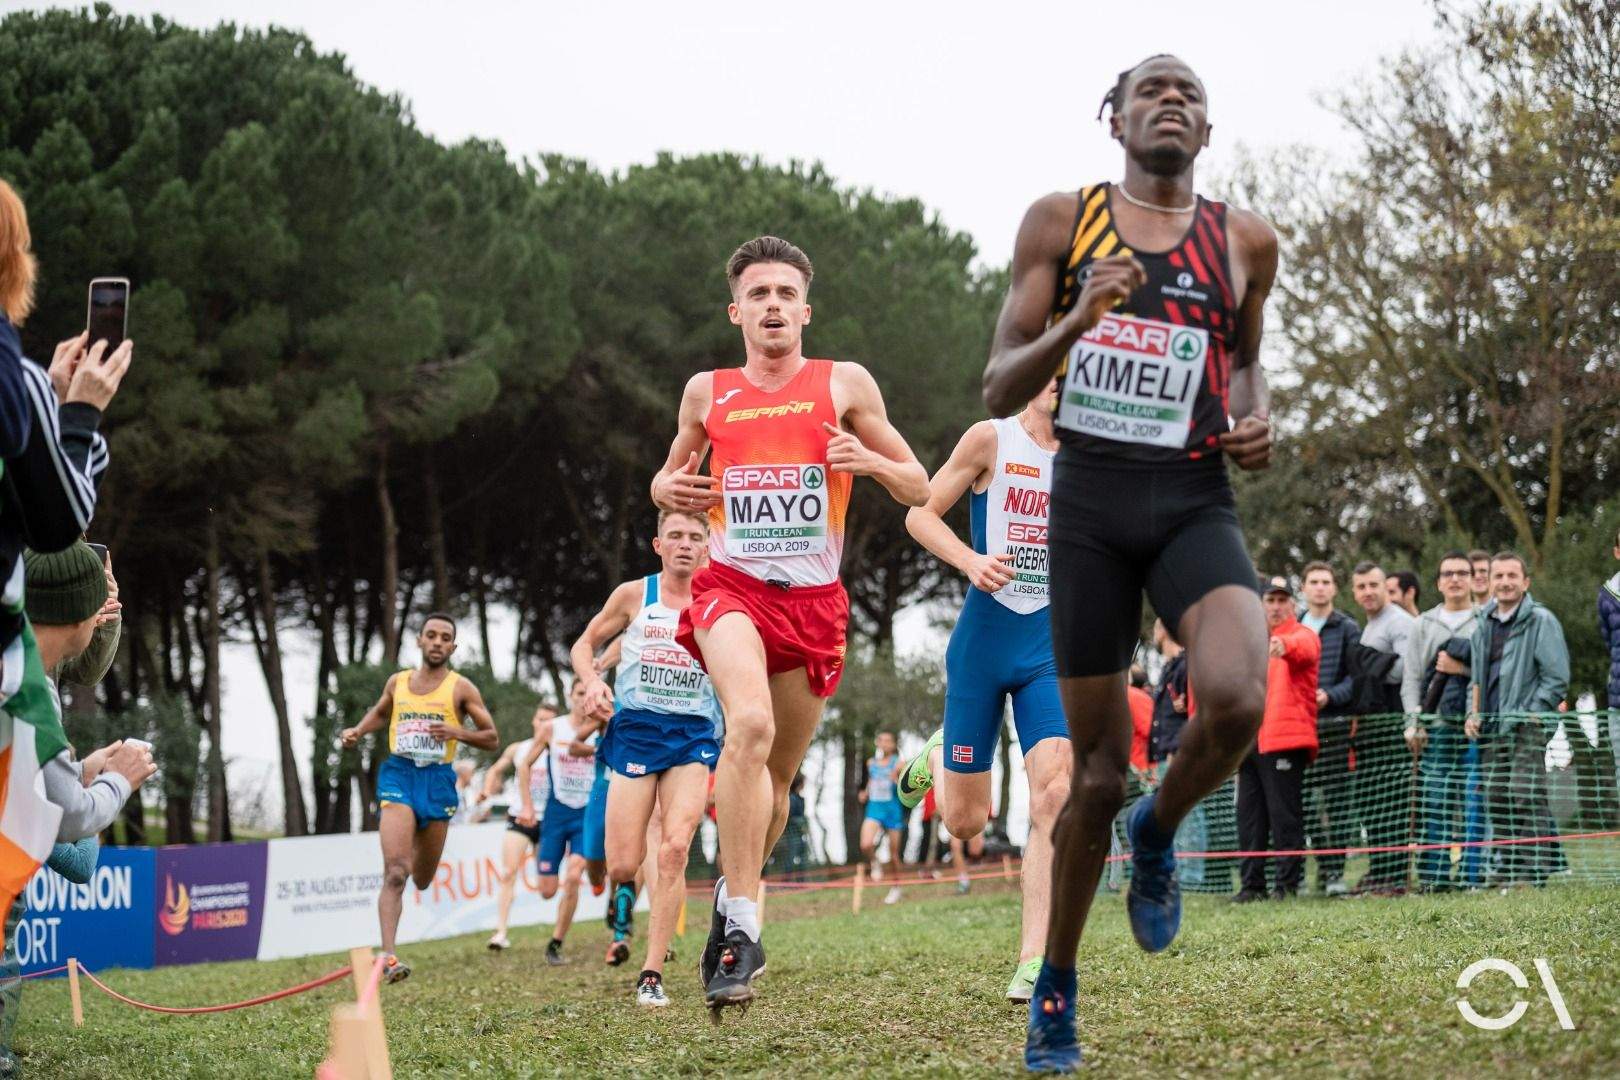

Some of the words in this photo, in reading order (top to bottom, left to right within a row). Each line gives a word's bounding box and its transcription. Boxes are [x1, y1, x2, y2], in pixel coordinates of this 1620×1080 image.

[1082, 319, 1169, 352] PAR
[1072, 348, 1193, 404] KIMELI
[725, 400, 815, 424] ESPAÑA
[1089, 398, 1116, 413] RUN
[1117, 402, 1160, 419] CLEAN
[1077, 413, 1130, 434] LISBOA
[1132, 422, 1163, 439] 2019
[725, 468, 800, 489] SPAR
[1018, 466, 1039, 477] EXTRA
[730, 493, 822, 524] MAYO
[1004, 486, 1050, 519] NOR
[749, 528, 772, 538] RUN
[772, 527, 803, 538] CLEAN
[1009, 524, 1049, 542] SPA
[742, 541, 782, 553] LISBOA
[785, 540, 810, 552] 2019
[1004, 544, 1050, 572] INGEBRI
[1021, 573, 1039, 583] RUN
[1013, 583, 1045, 596] LISBOA
[641, 649, 691, 668] SPAR
[640, 664, 705, 690] BUTCHART
[647, 695, 674, 706] LISBOA
[675, 698, 691, 708] 2019
[653, 688, 668, 696] RUN
[668, 689, 688, 698] CLEAN
[397, 734, 444, 752] SOLOMON
[14, 917, 62, 967] ORT
